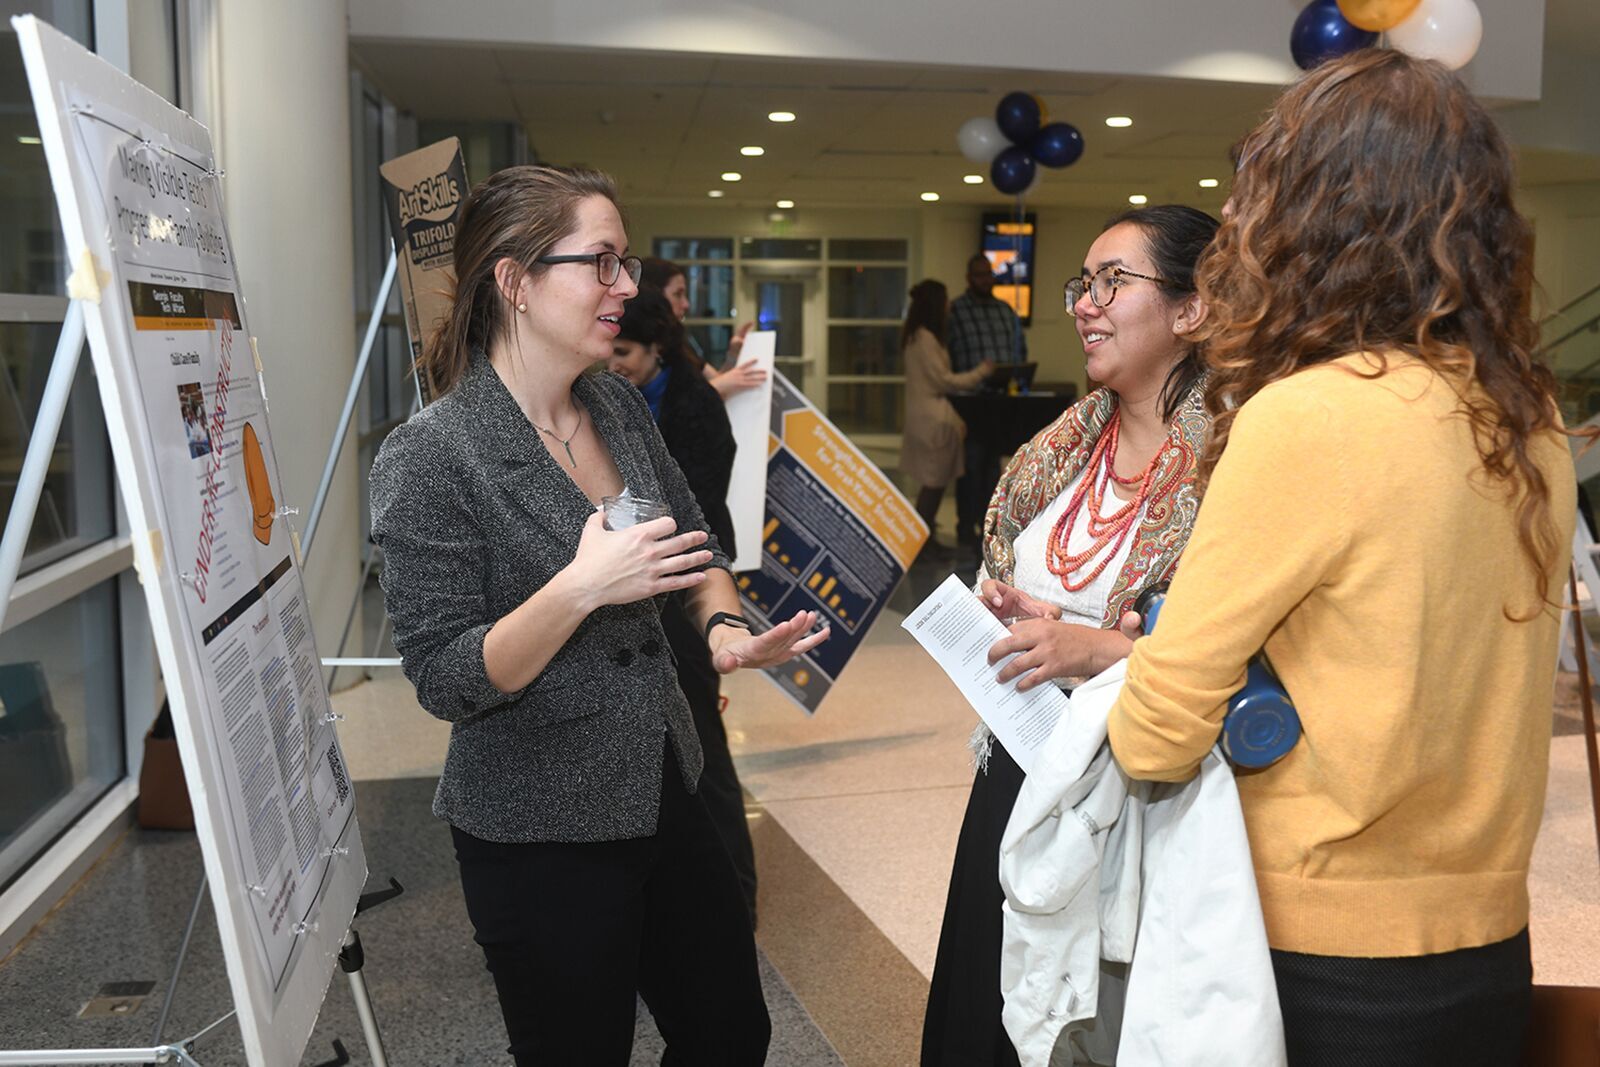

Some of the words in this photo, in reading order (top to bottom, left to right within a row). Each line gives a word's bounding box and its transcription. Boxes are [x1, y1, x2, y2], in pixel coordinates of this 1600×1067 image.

[149, 160, 186, 200] Visible
[400, 173, 460, 219] ArtSkills
[115, 196, 157, 246] Progre
[412, 222, 456, 248] TRIFOLD
[194, 499, 216, 604] UNDER
